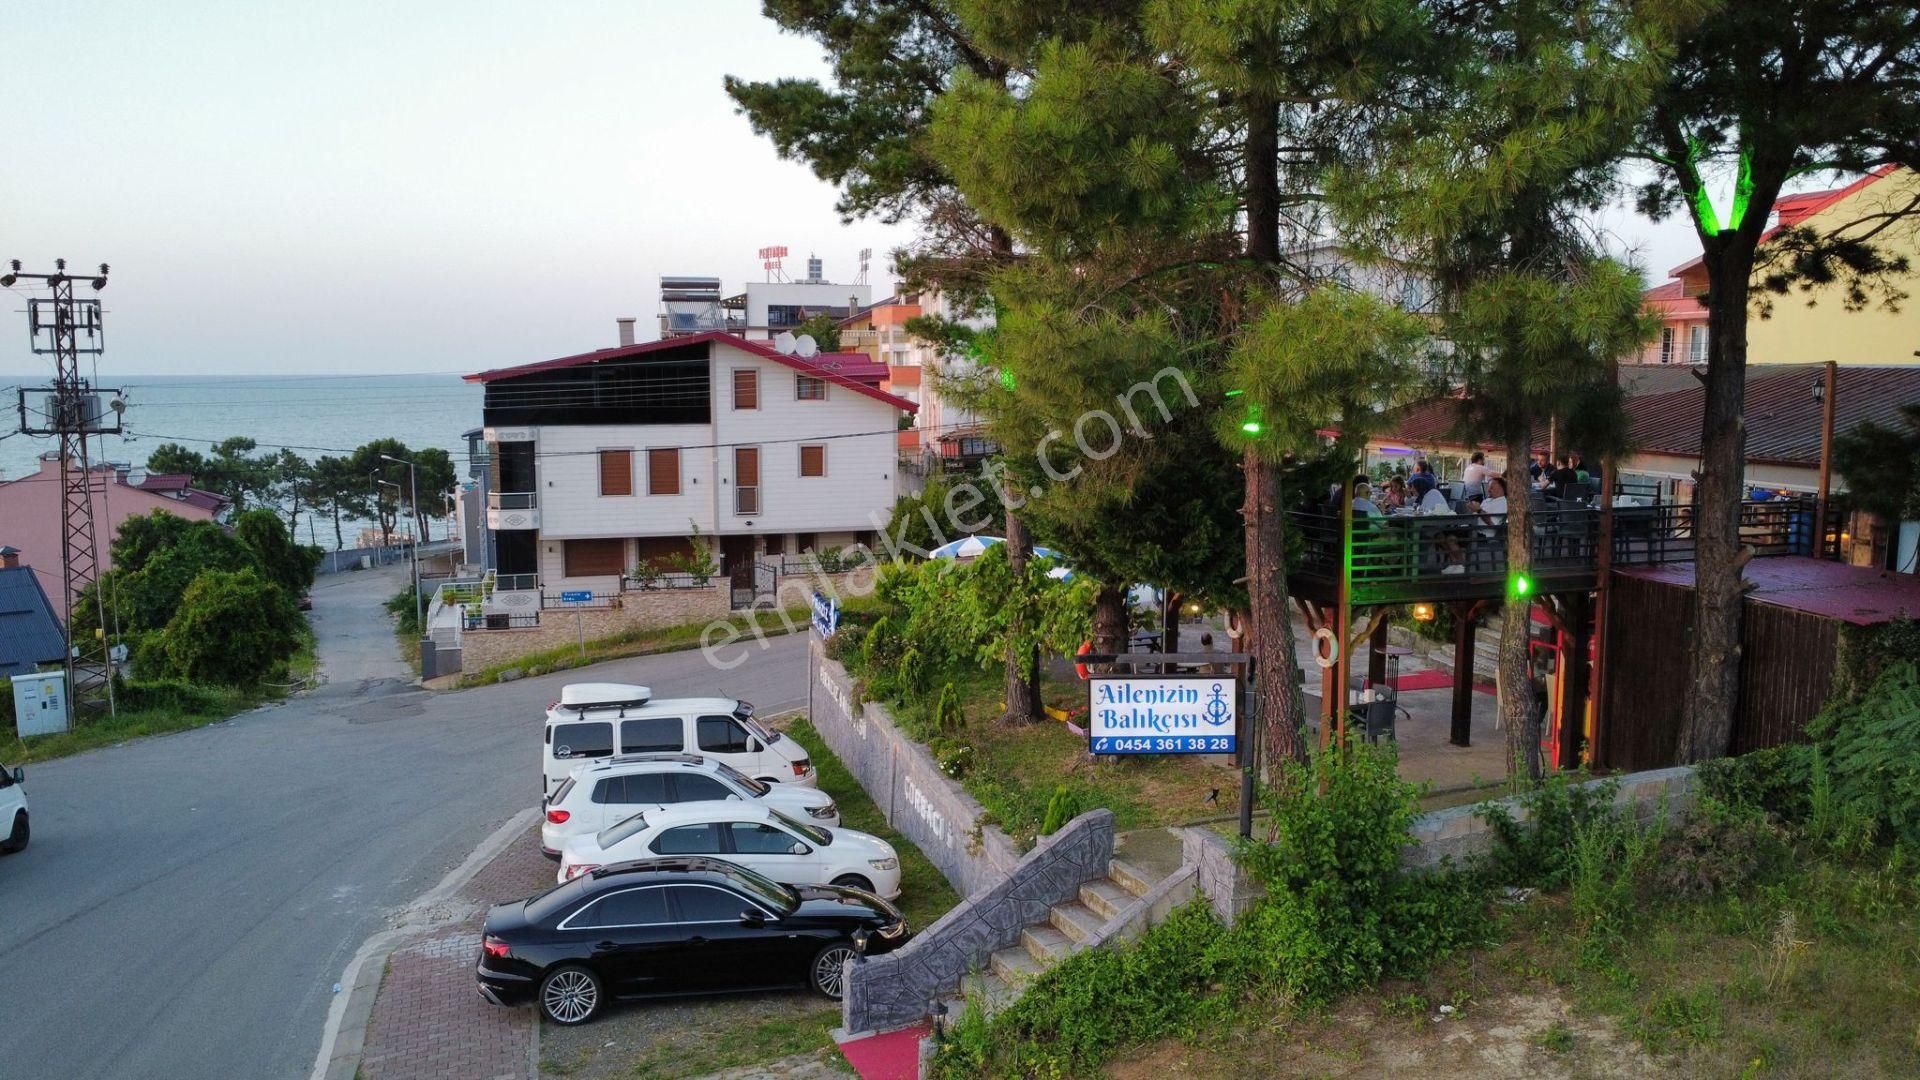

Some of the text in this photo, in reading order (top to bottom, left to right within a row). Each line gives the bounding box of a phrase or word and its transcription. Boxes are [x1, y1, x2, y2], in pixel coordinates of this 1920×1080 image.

[1096, 683, 1199, 705] Ailenizin
[1098, 708, 1198, 734] Balıkçısı
[1115, 738, 1229, 751] 0454 361 38 28
